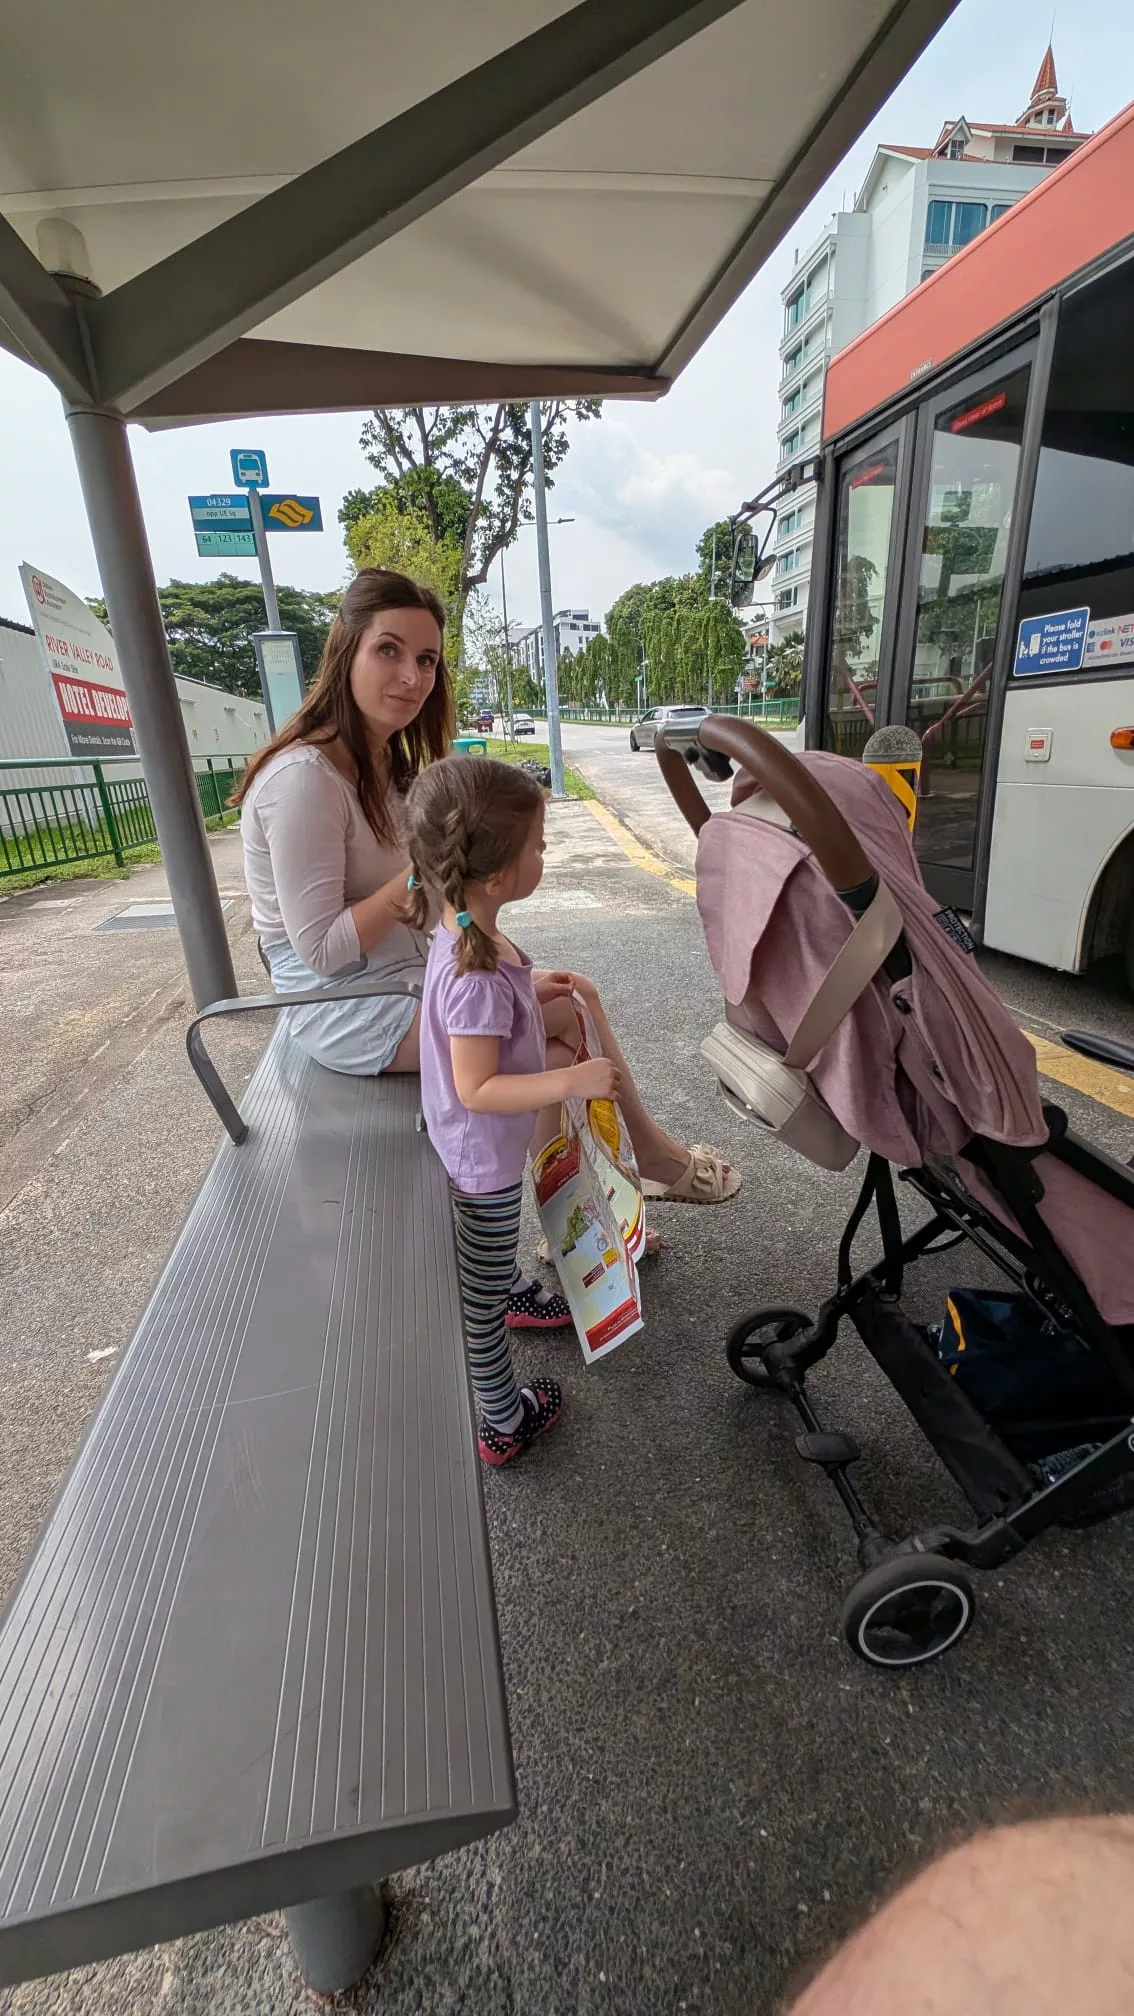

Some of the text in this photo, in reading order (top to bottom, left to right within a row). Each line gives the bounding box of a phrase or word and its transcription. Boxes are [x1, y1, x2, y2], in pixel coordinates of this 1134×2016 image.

[206, 497, 231, 506] 04329
[219, 534, 232, 543] 123
[237, 534, 251, 543] 143
[1044, 618, 1082, 633] Please fold
[1042, 631, 1083, 646] your stroller
[45, 634, 114, 671] RIVER VALLEY ROAD
[1042, 645, 1047, 654] if
[1047, 644, 1057, 653] the
[1059, 642, 1071, 651] bus
[1072, 642, 1079, 650] is
[1040, 653, 1069, 664] crowded
[58, 682, 94, 716] HOTEL
[944, 910, 975, 950] PROTECTION
